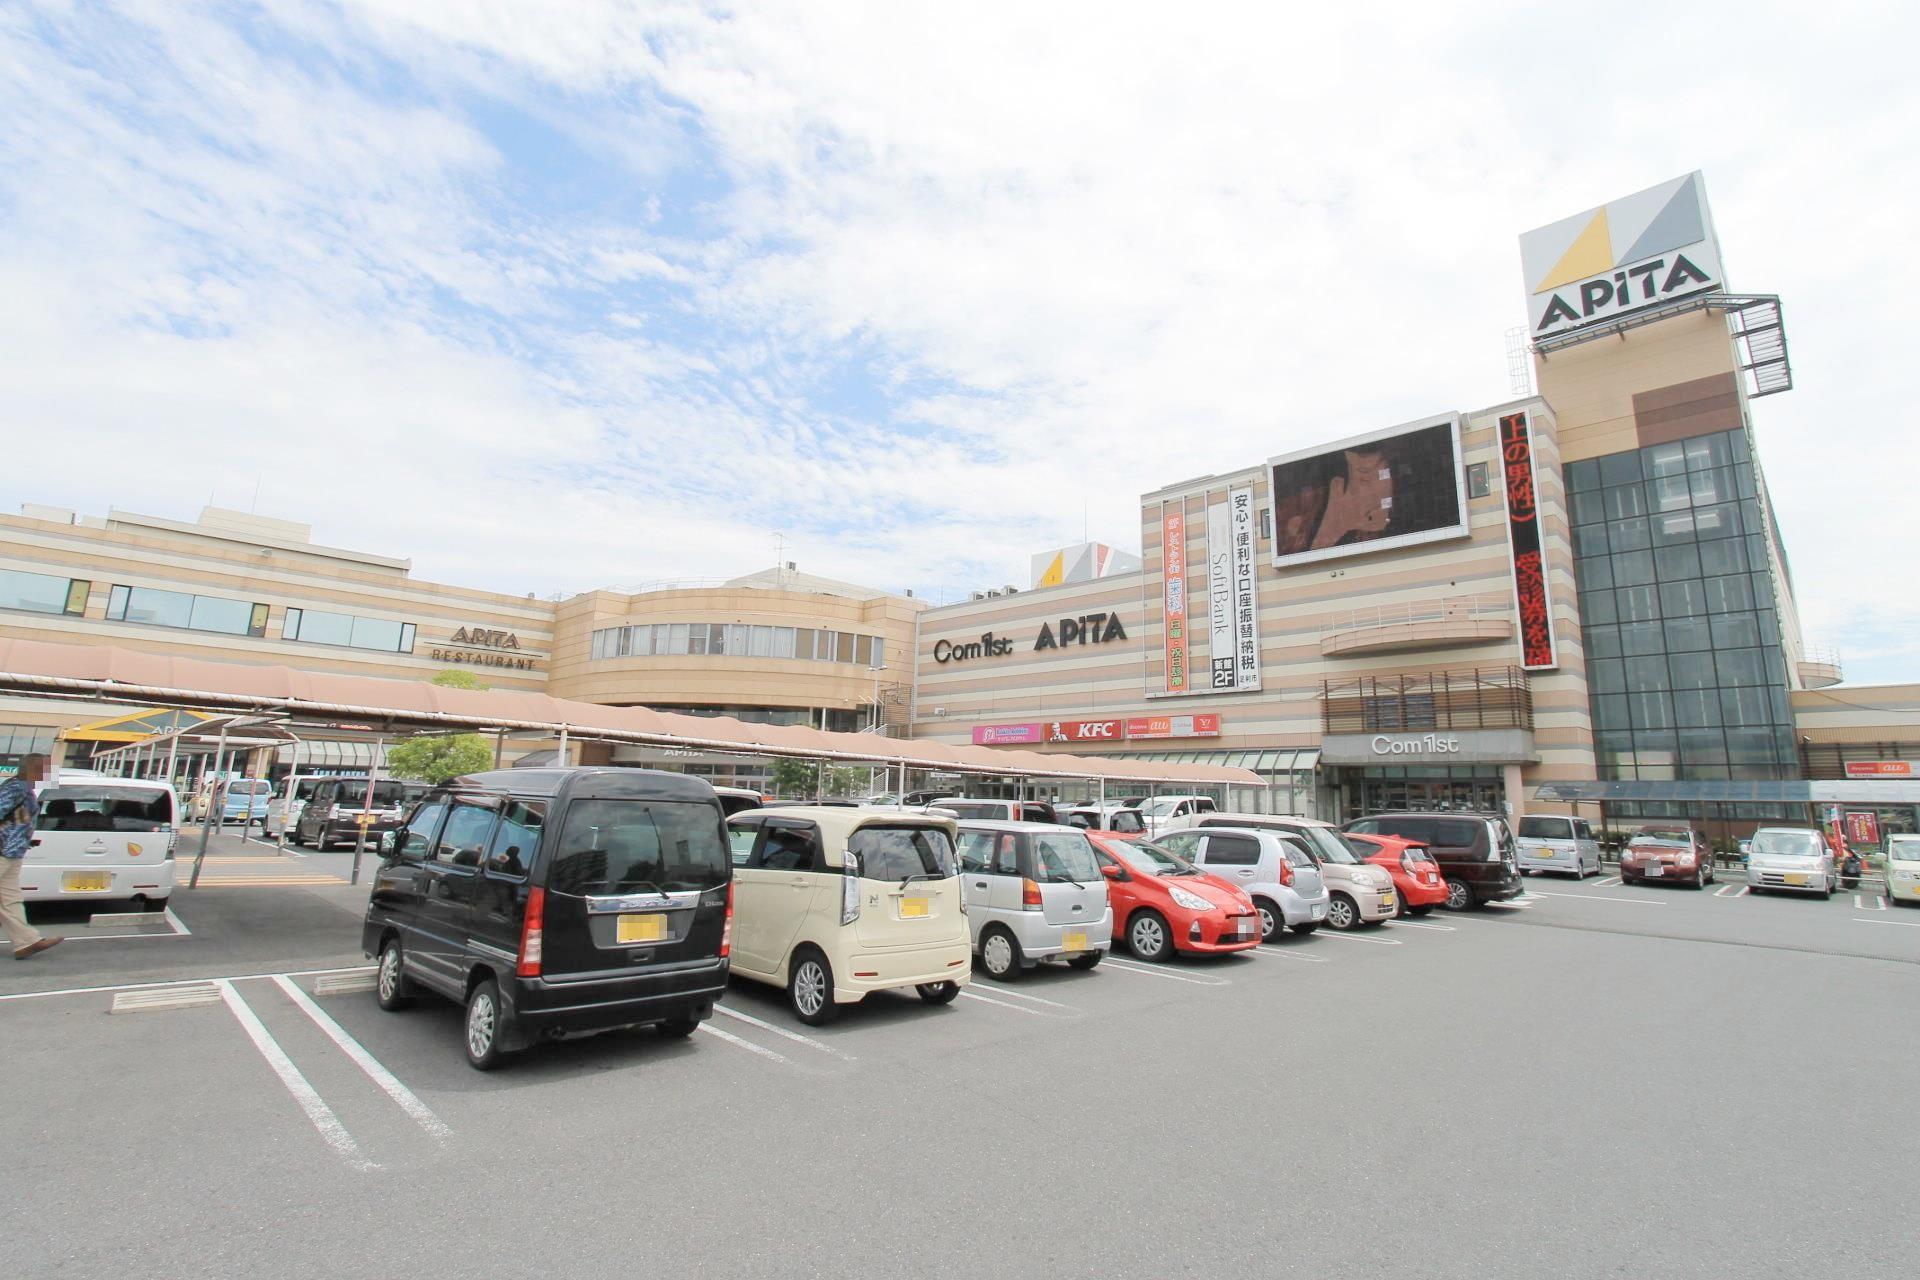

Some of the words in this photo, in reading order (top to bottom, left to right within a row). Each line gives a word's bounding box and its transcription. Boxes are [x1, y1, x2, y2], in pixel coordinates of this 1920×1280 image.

[1212, 553, 1229, 635] SoftBank
[431, 648, 536, 670] RESTAURANT
[1214, 659, 1233, 670] 新館
[1214, 670, 1233, 687] 2F
[1076, 721, 1115, 738] KFC
[1150, 721, 1169, 730] au
[1882, 763, 1905, 771] au
